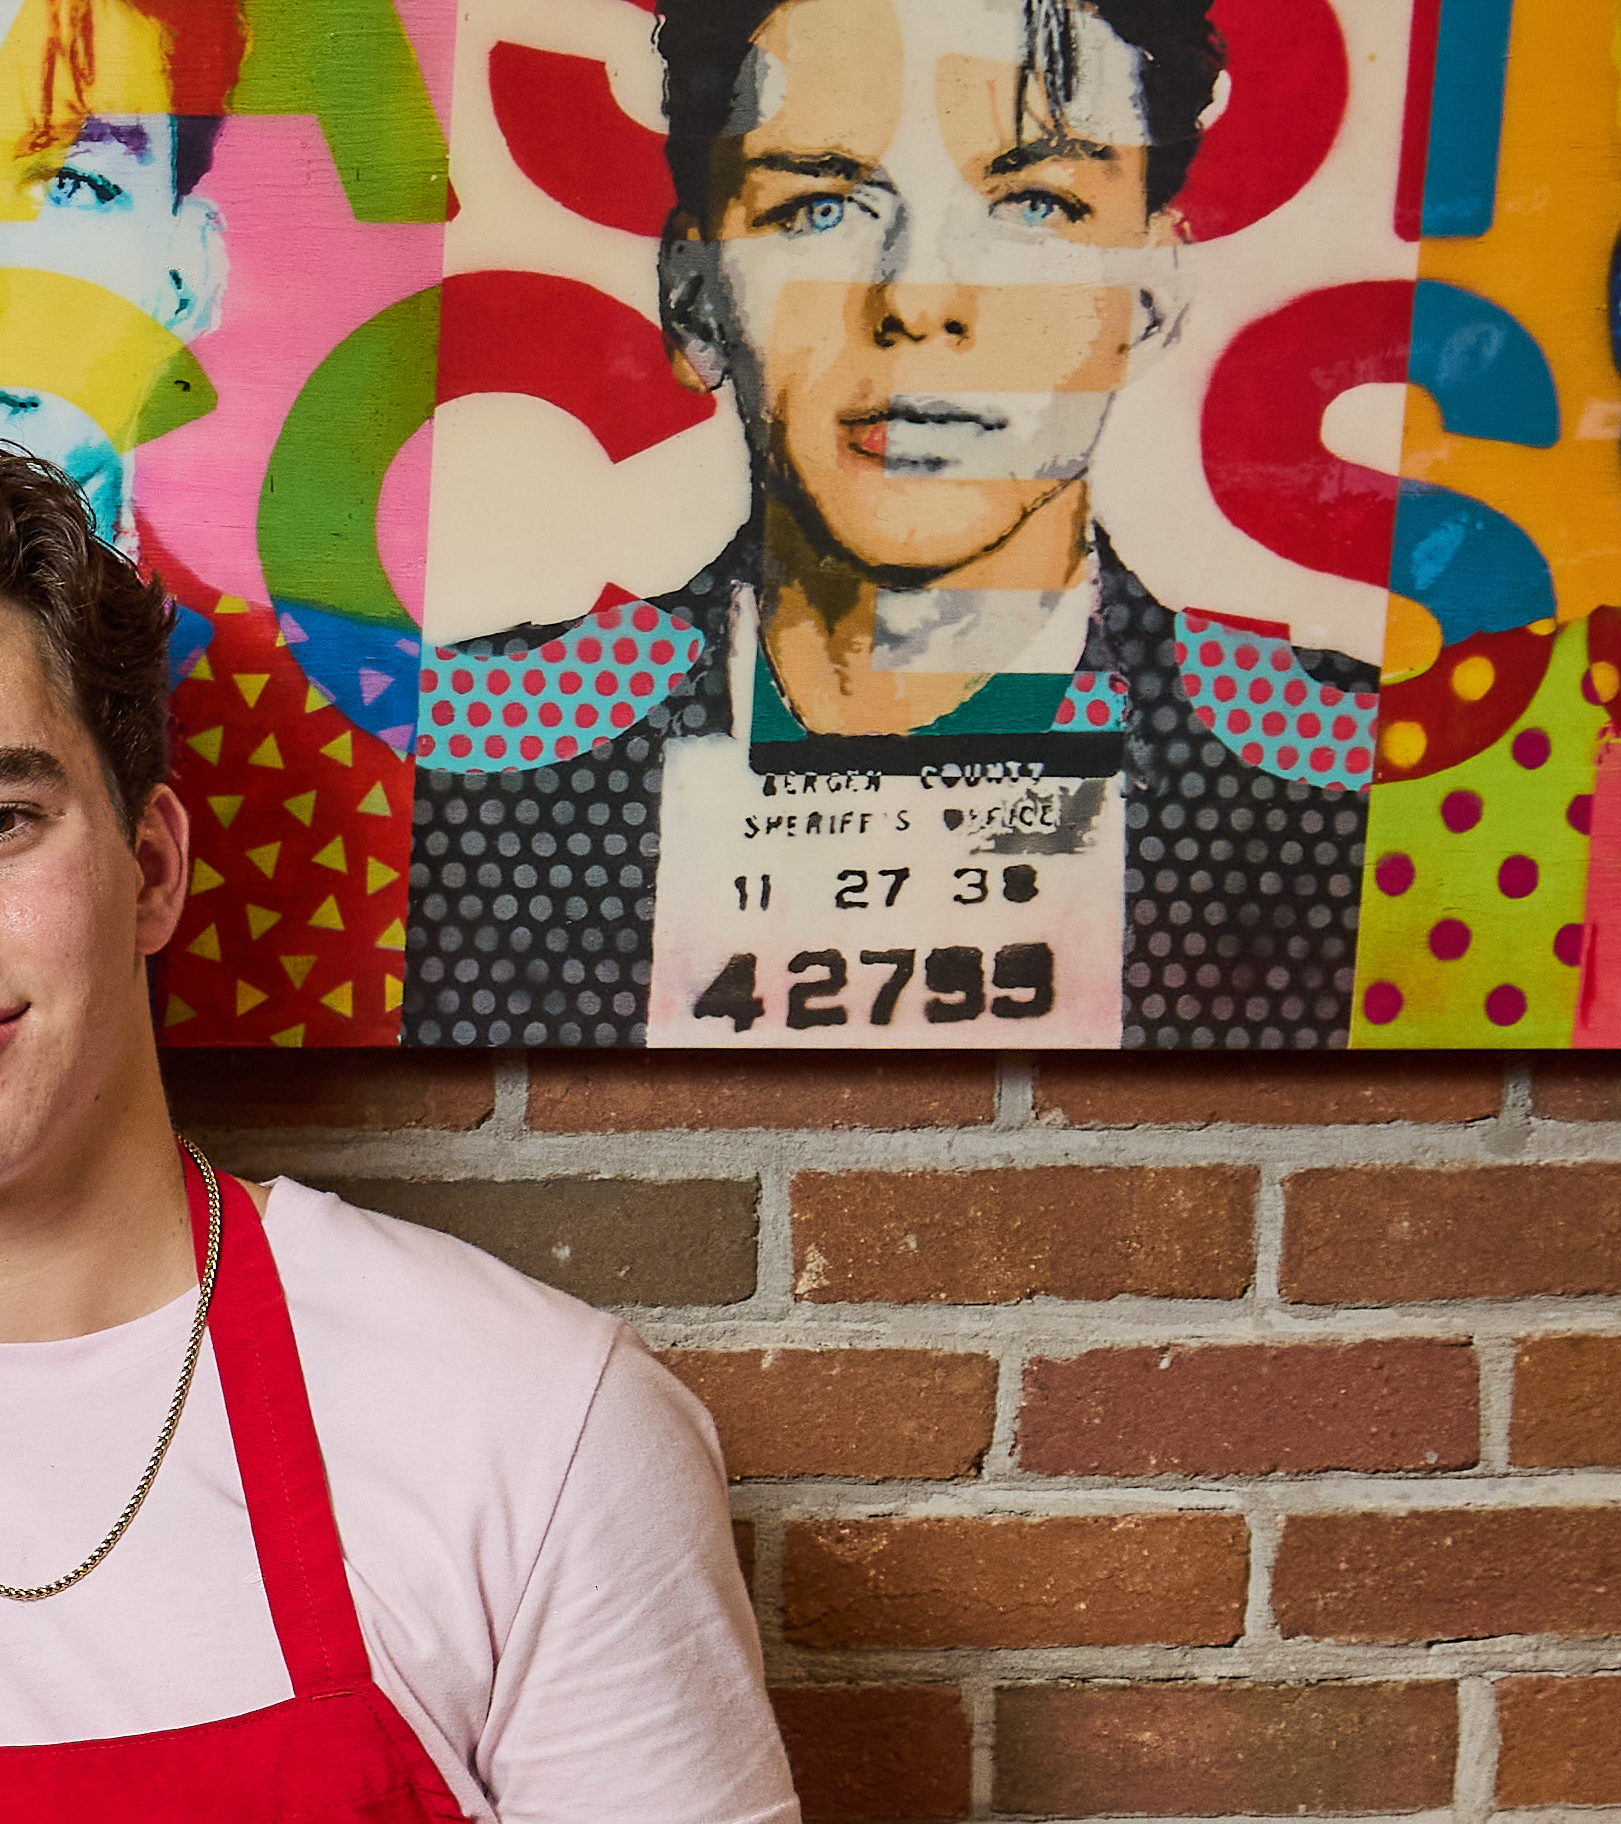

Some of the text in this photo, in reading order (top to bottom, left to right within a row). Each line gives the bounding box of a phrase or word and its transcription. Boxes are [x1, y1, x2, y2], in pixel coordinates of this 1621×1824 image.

[732, 873, 772, 911] 11
[835, 867, 911, 909] 27
[692, 942, 1055, 1033] 42799
